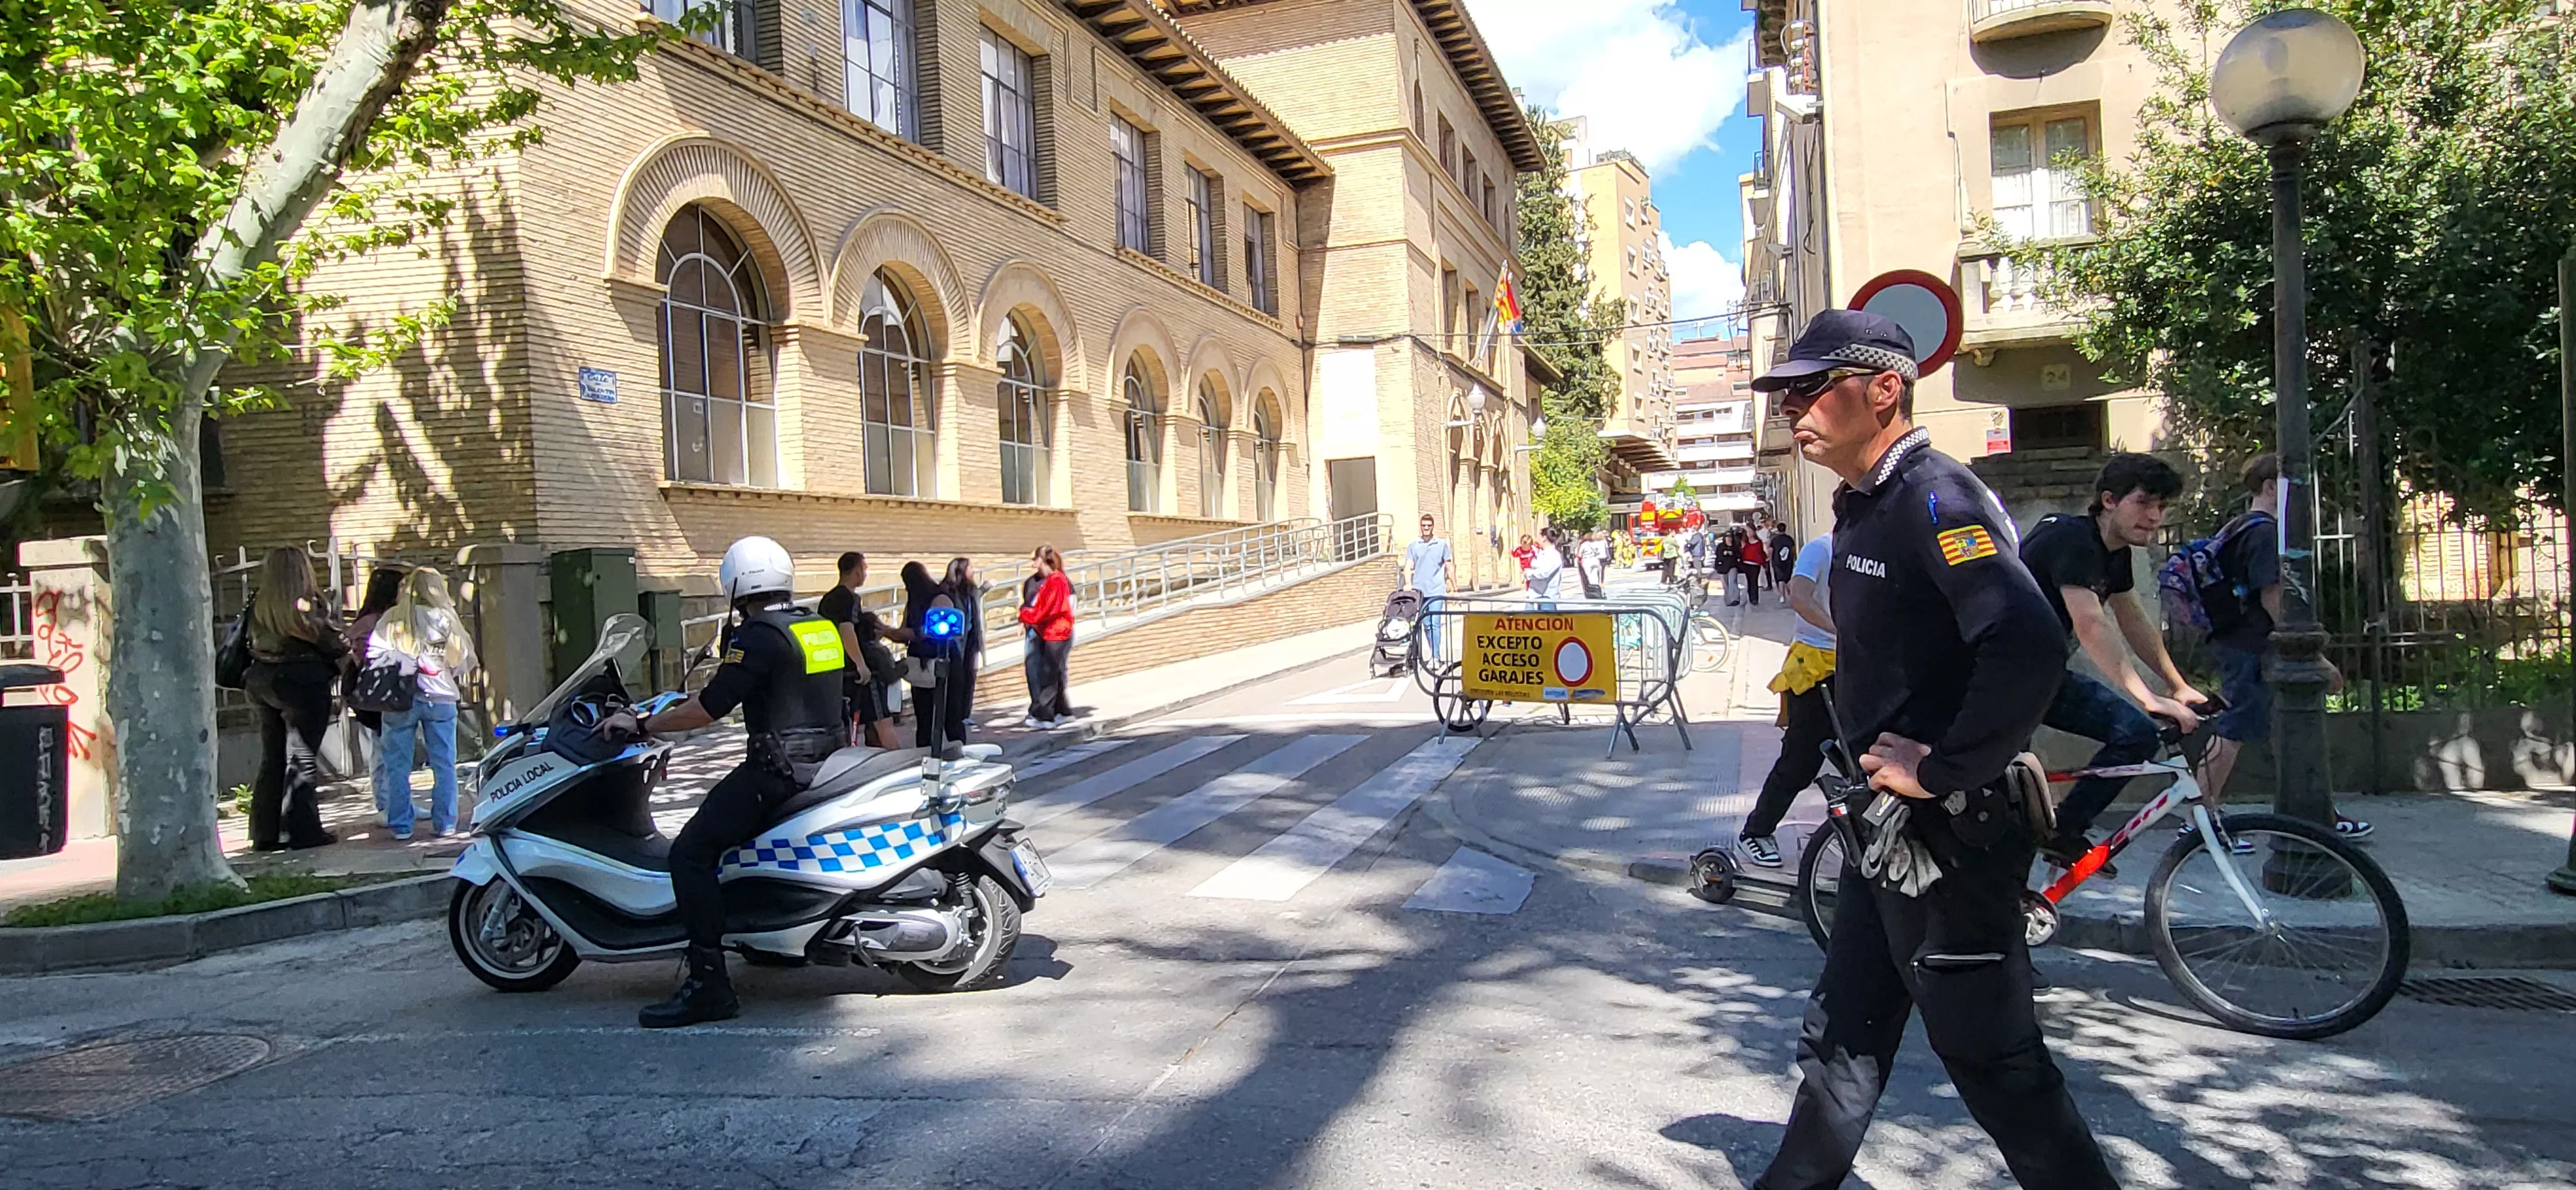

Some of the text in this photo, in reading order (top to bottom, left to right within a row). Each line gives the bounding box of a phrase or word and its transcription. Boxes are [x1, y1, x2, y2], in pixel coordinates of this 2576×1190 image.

[1846, 554, 1886, 578] POLICIA
[1494, 617, 1573, 631] ATENCION
[1477, 635, 1542, 650] EXCEPTO
[1482, 652, 1540, 667] ACCESO
[1479, 668, 1544, 685] GARAJES
[490, 761, 554, 804] POLICIA LOCAL
